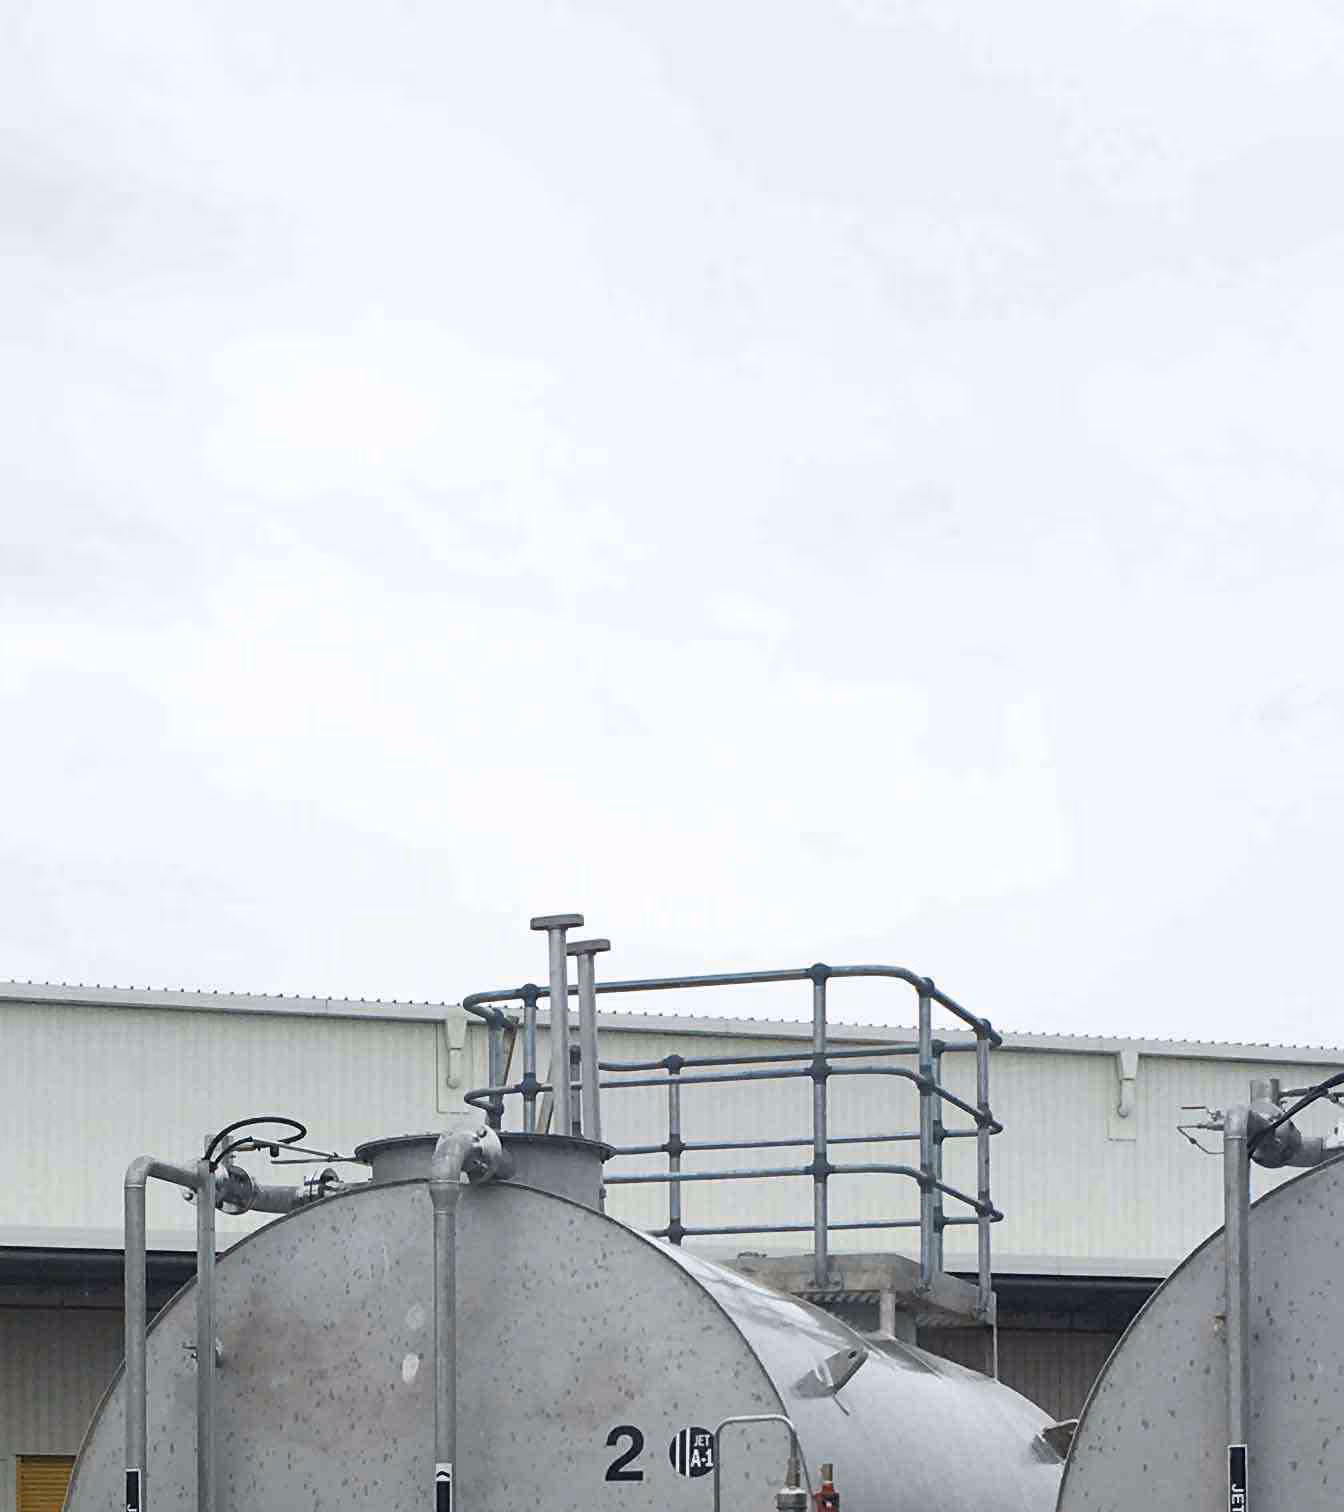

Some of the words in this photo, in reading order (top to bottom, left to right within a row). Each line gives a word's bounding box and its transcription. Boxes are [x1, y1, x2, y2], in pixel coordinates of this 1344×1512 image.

[693, 1434, 710, 1447] JET
[605, 1425, 644, 1481] 2
[690, 1449, 714, 1468] A-1
